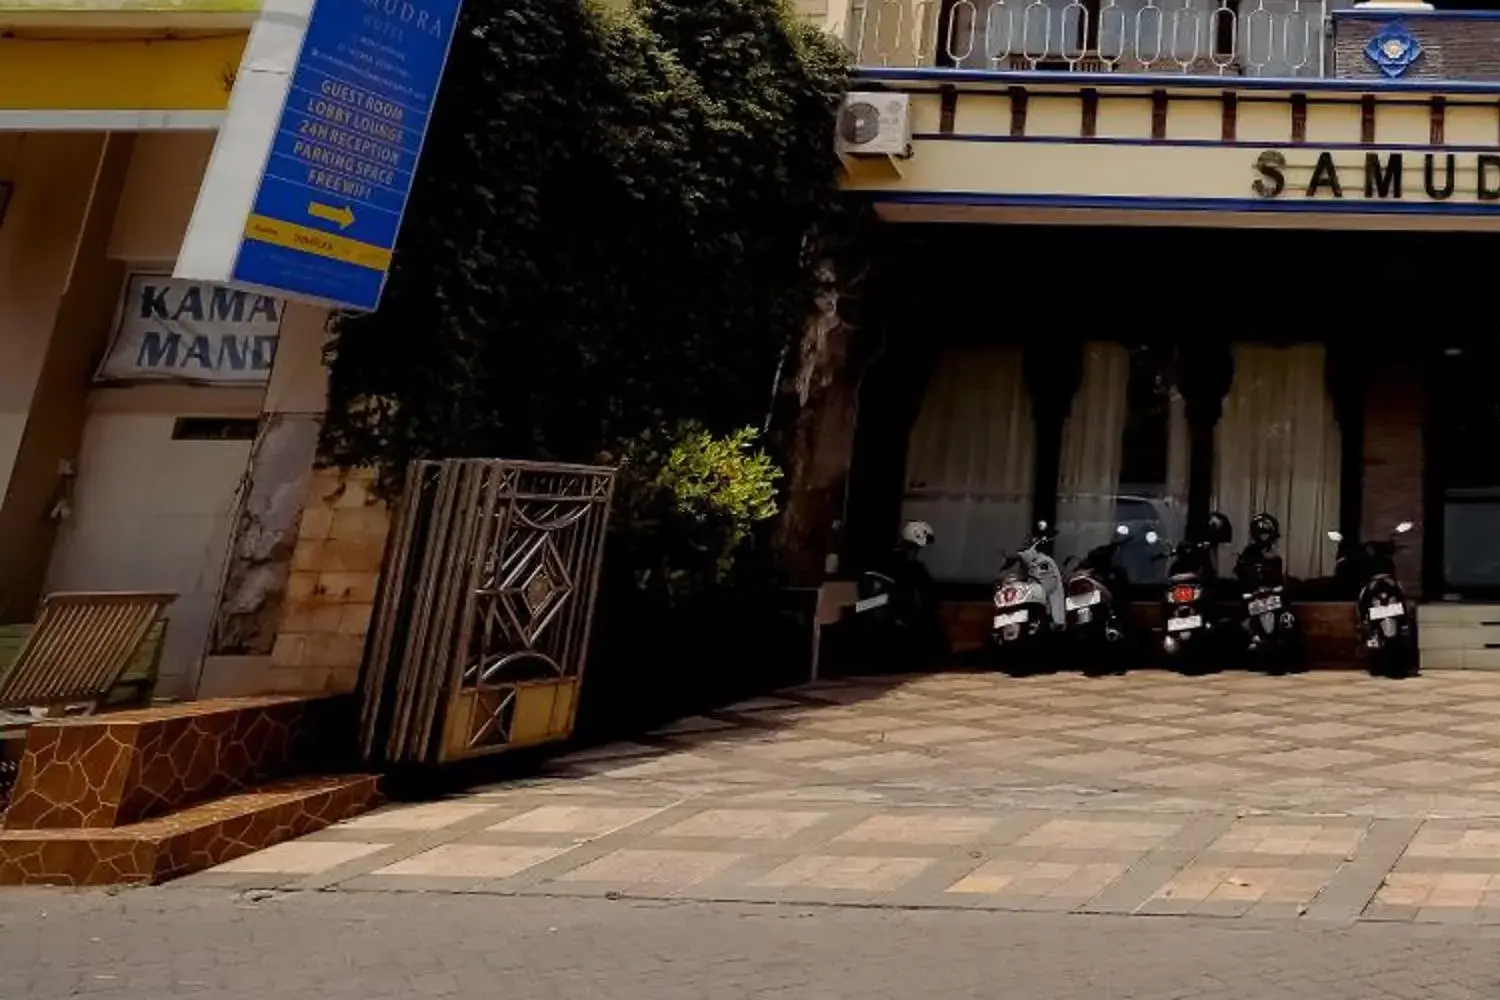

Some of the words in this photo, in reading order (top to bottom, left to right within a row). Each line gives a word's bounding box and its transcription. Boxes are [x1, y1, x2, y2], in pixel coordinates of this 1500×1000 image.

[321, 79, 363, 106] GUEST
[365, 96, 403, 121] ROOM
[308, 97, 353, 124] LOBBY
[353, 113, 404, 144] LOUNGE
[293, 140, 356, 172] PARKING
[356, 161, 396, 186] SPACE
[329, 128, 399, 165] RECEPTION
[307, 169, 342, 191] FREE
[140, 284, 279, 323] KAMA
